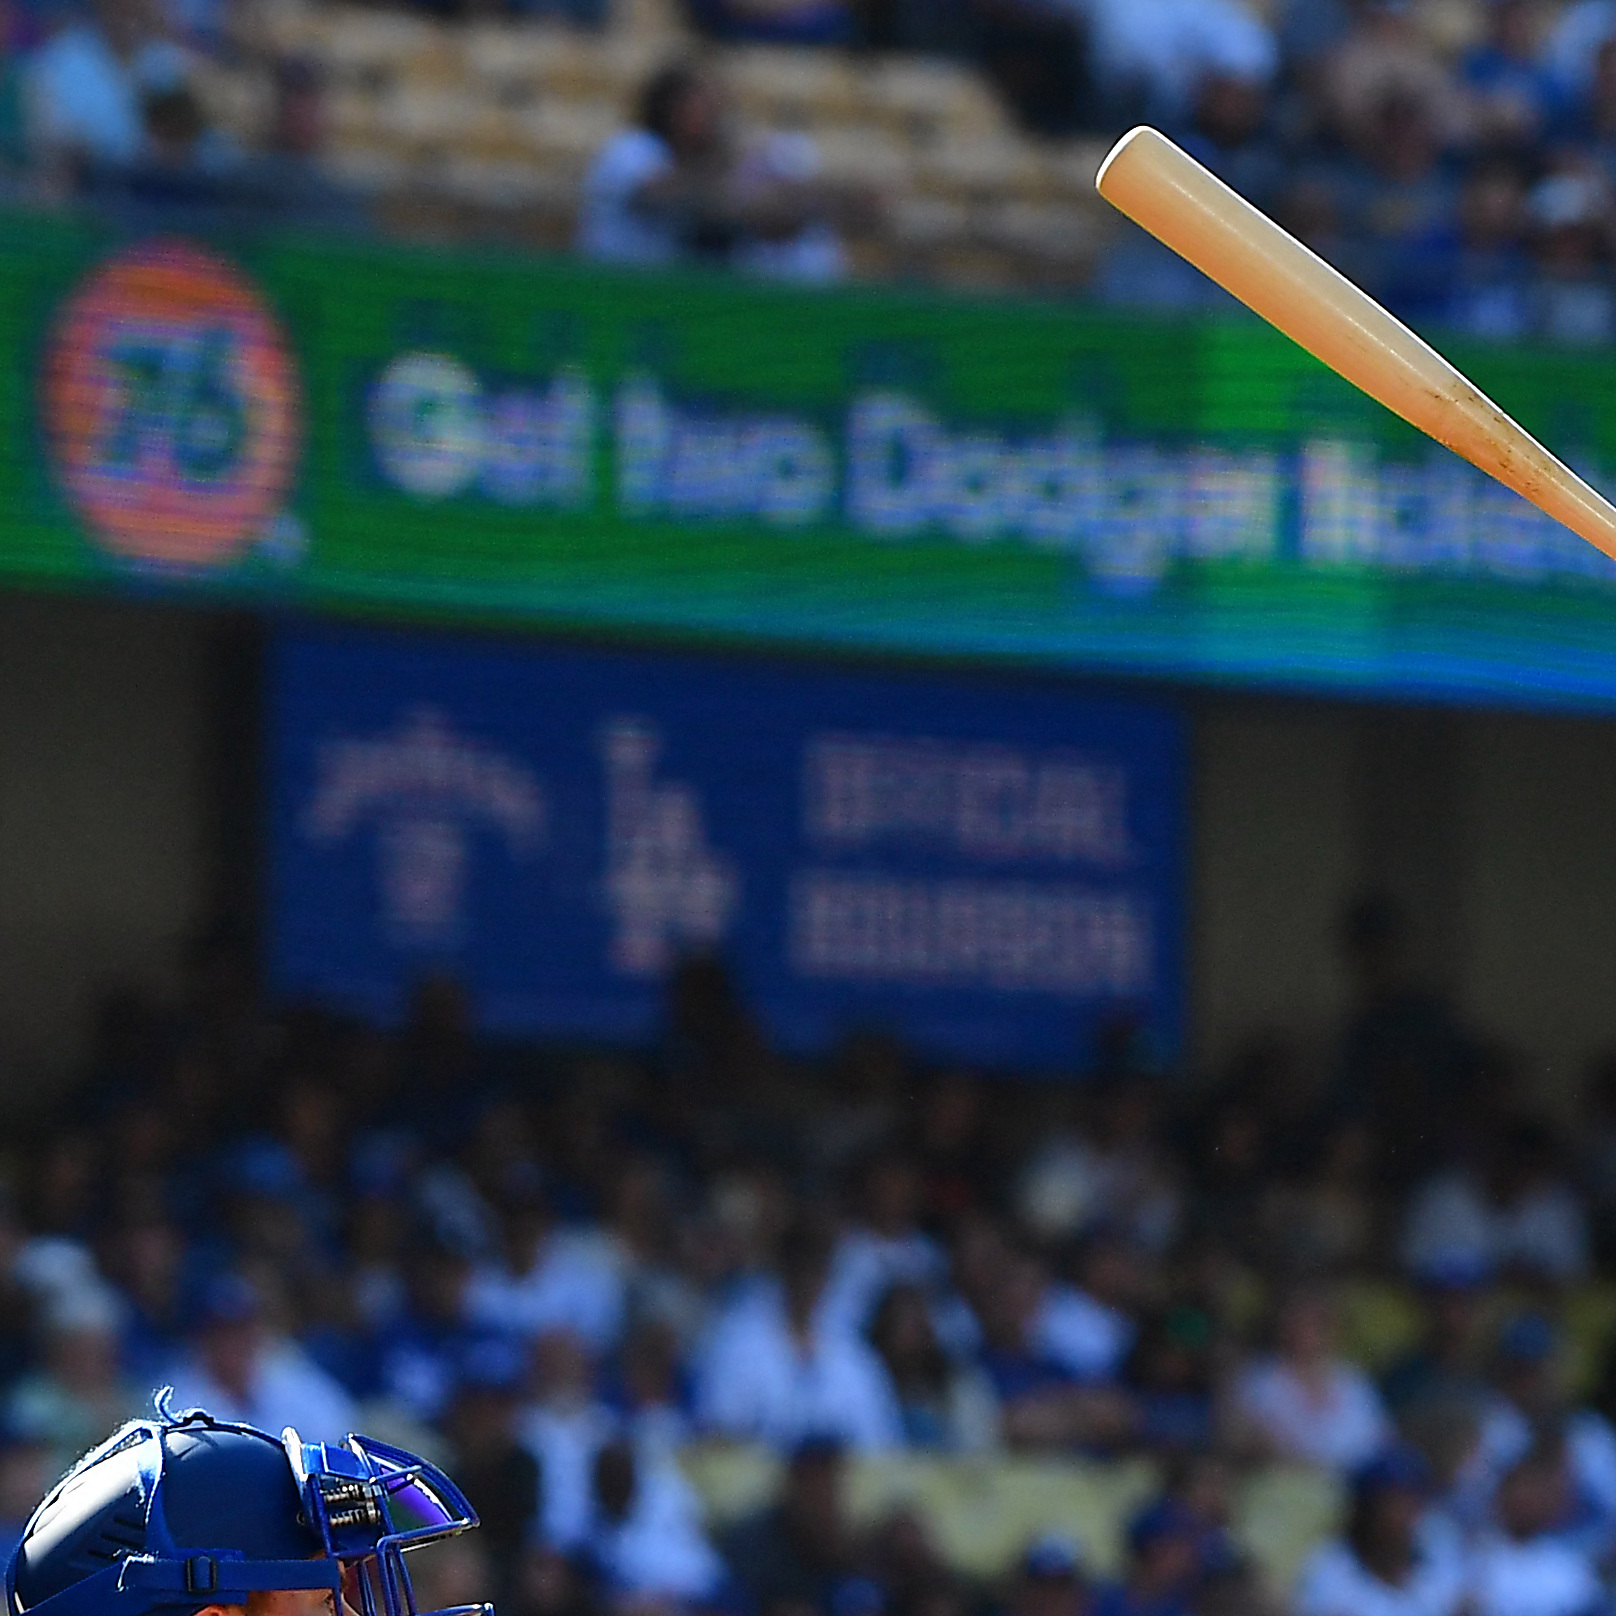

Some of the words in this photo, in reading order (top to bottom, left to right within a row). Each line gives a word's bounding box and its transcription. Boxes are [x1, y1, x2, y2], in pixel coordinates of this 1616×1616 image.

[96, 325, 252, 490] 76
[368, 348, 596, 512] Get
[614, 372, 836, 530] two
[844, 386, 1284, 602] Dodger
